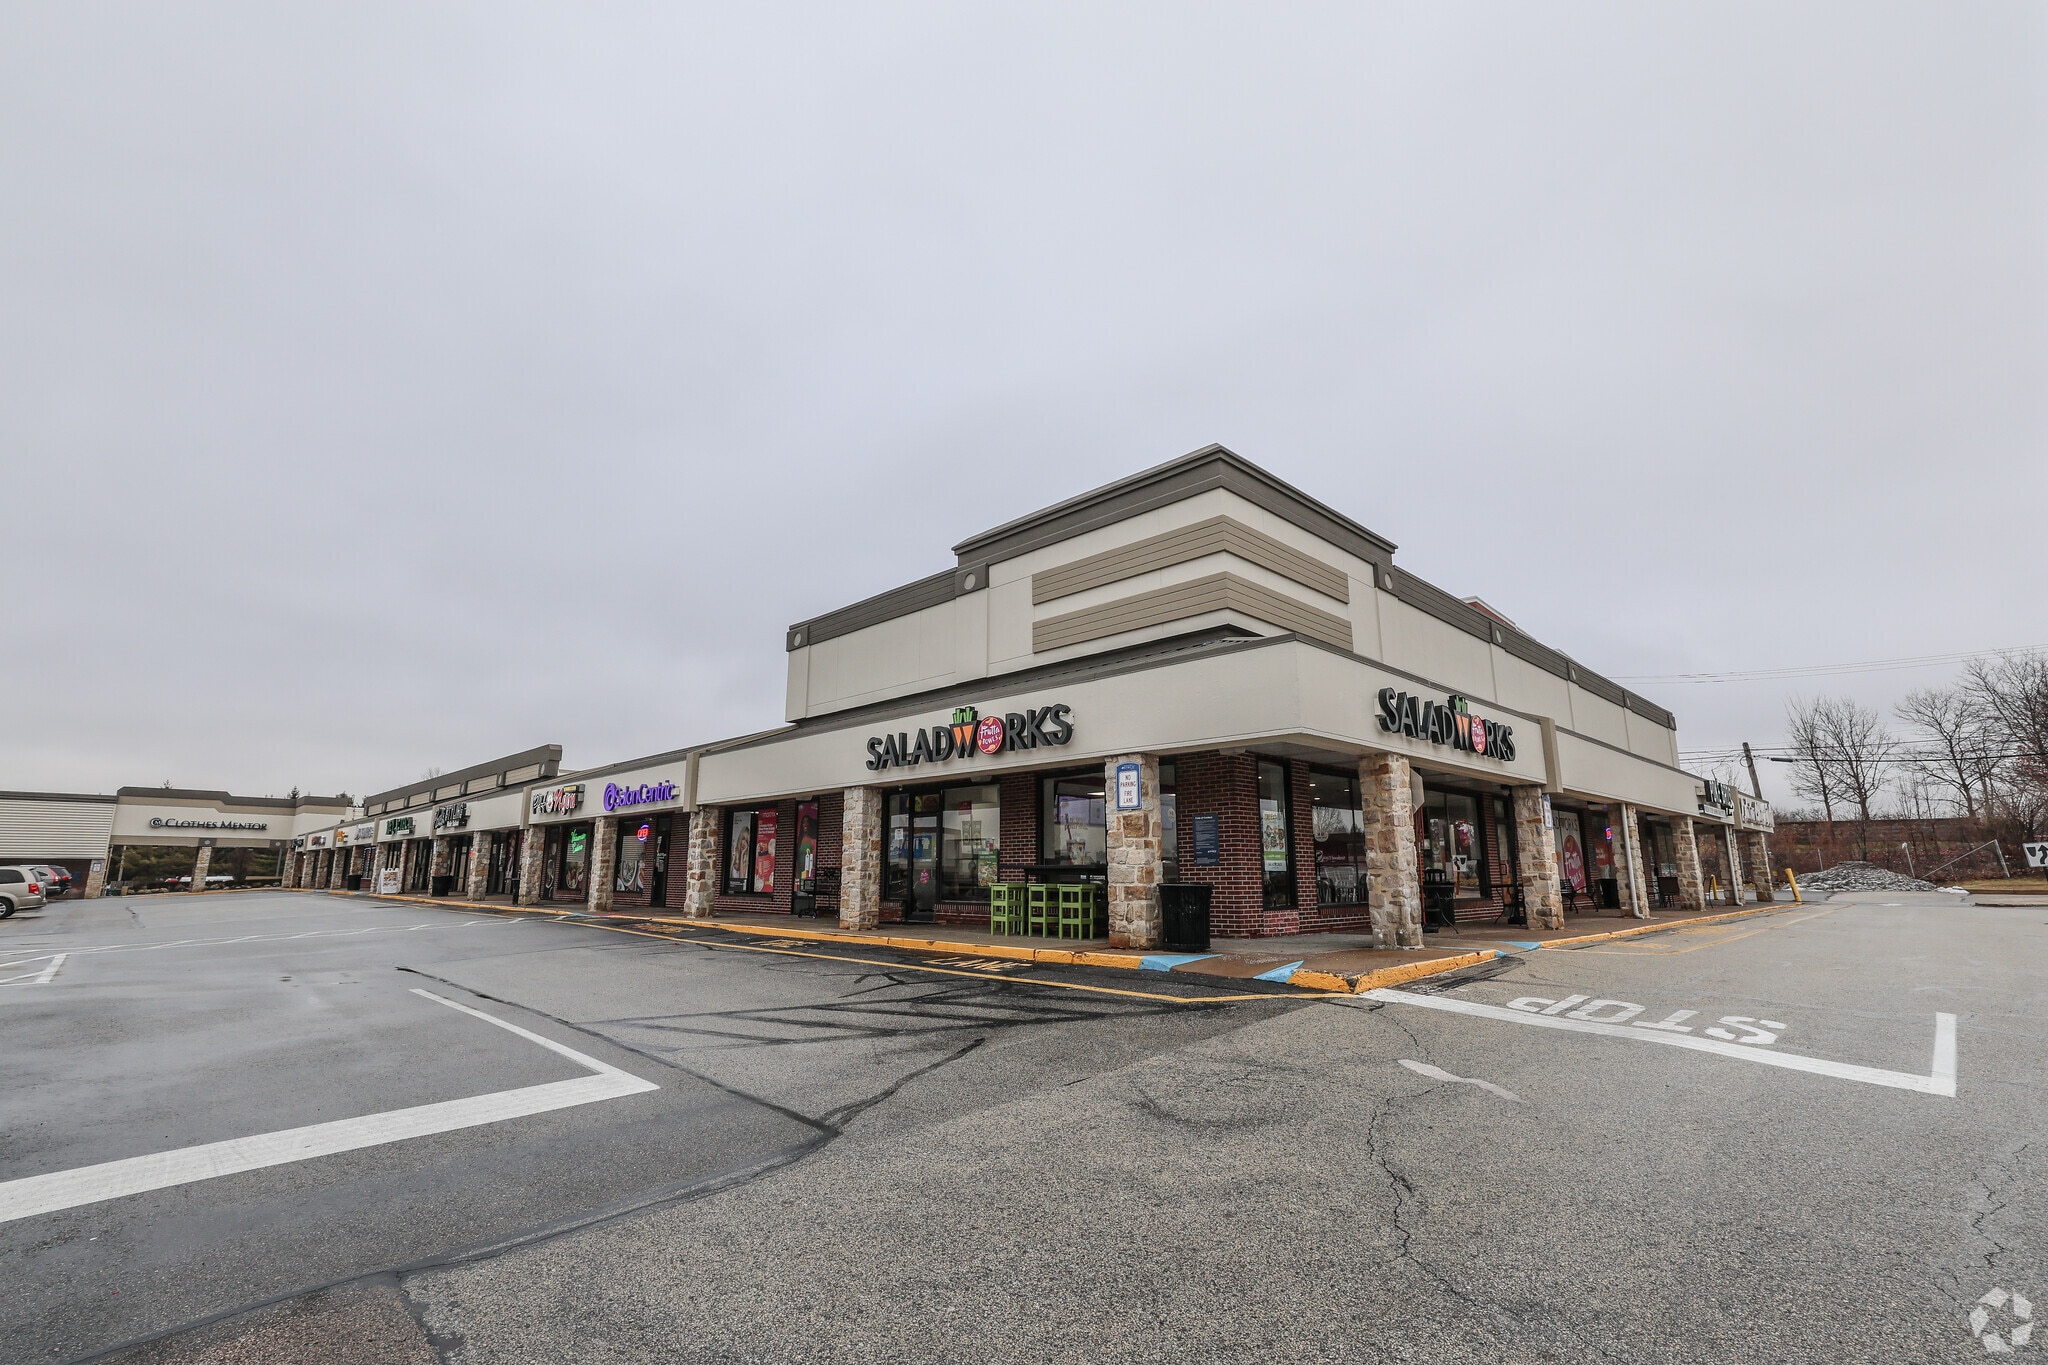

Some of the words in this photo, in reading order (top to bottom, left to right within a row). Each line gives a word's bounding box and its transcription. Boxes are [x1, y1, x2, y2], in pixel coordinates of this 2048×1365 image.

[614, 780, 675, 807] SalonCentric
[165, 818, 217, 829] CLOTHES
[219, 820, 267, 830] MENTOR
[1506, 994, 1787, 1045] STOP
